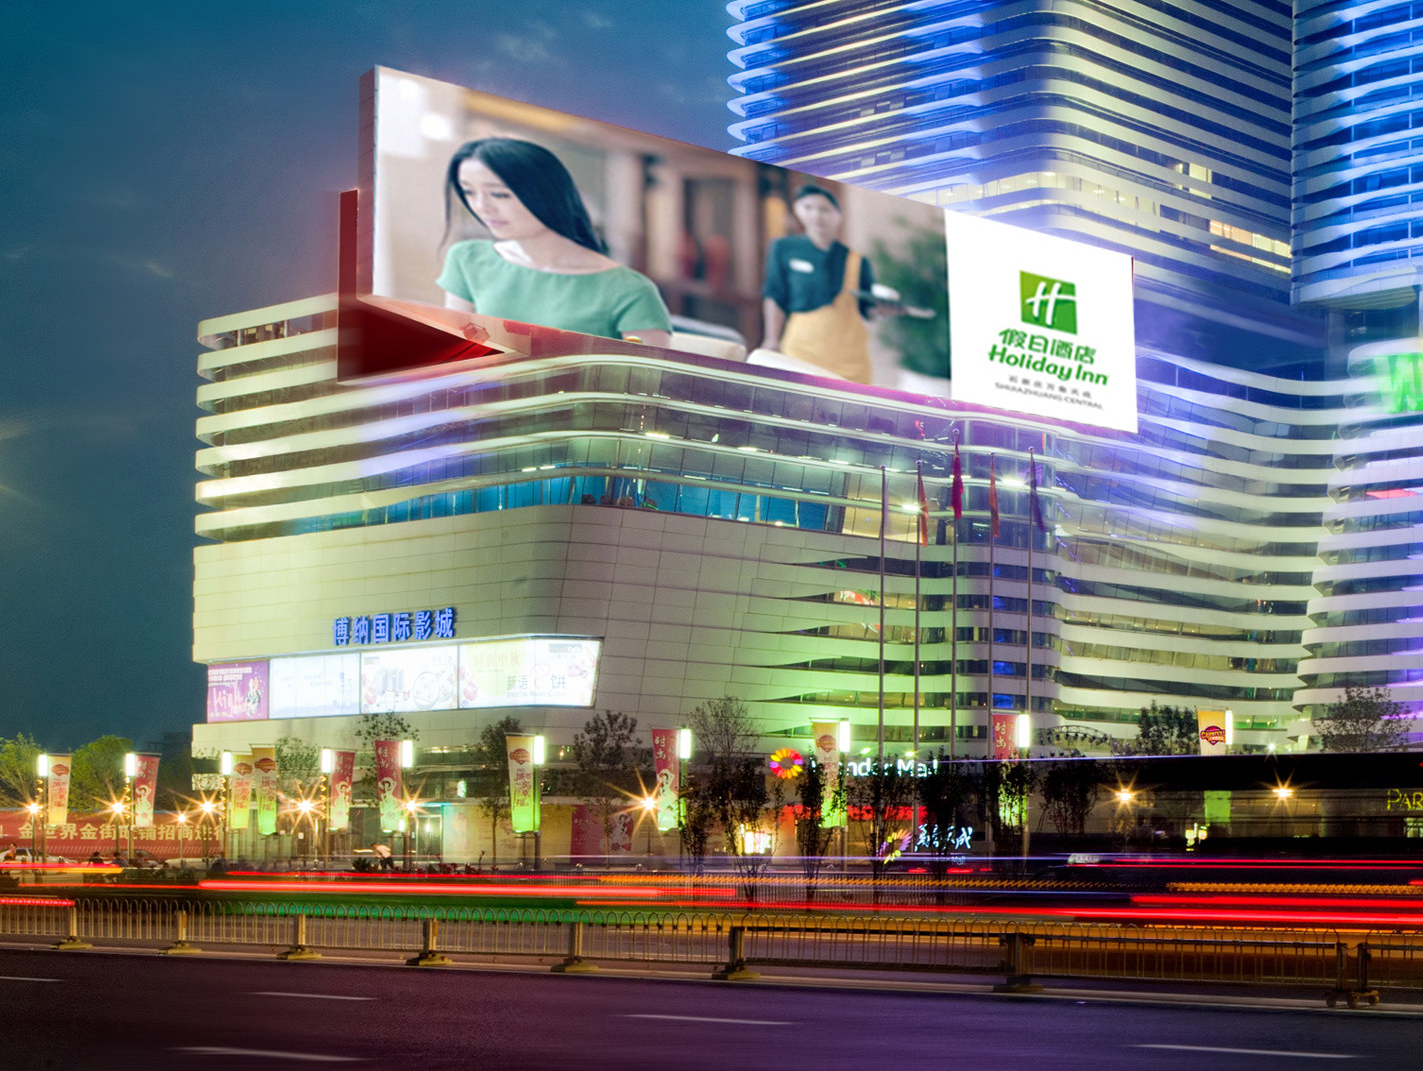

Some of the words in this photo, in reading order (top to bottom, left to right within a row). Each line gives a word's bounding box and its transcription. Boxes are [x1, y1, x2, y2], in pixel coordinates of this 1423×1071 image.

[987, 344, 1073, 382] Holiday
[1075, 364, 1111, 386] Inn
[998, 328, 1097, 364] 假日酒店
[331, 606, 457, 647] 博纳国际影城
